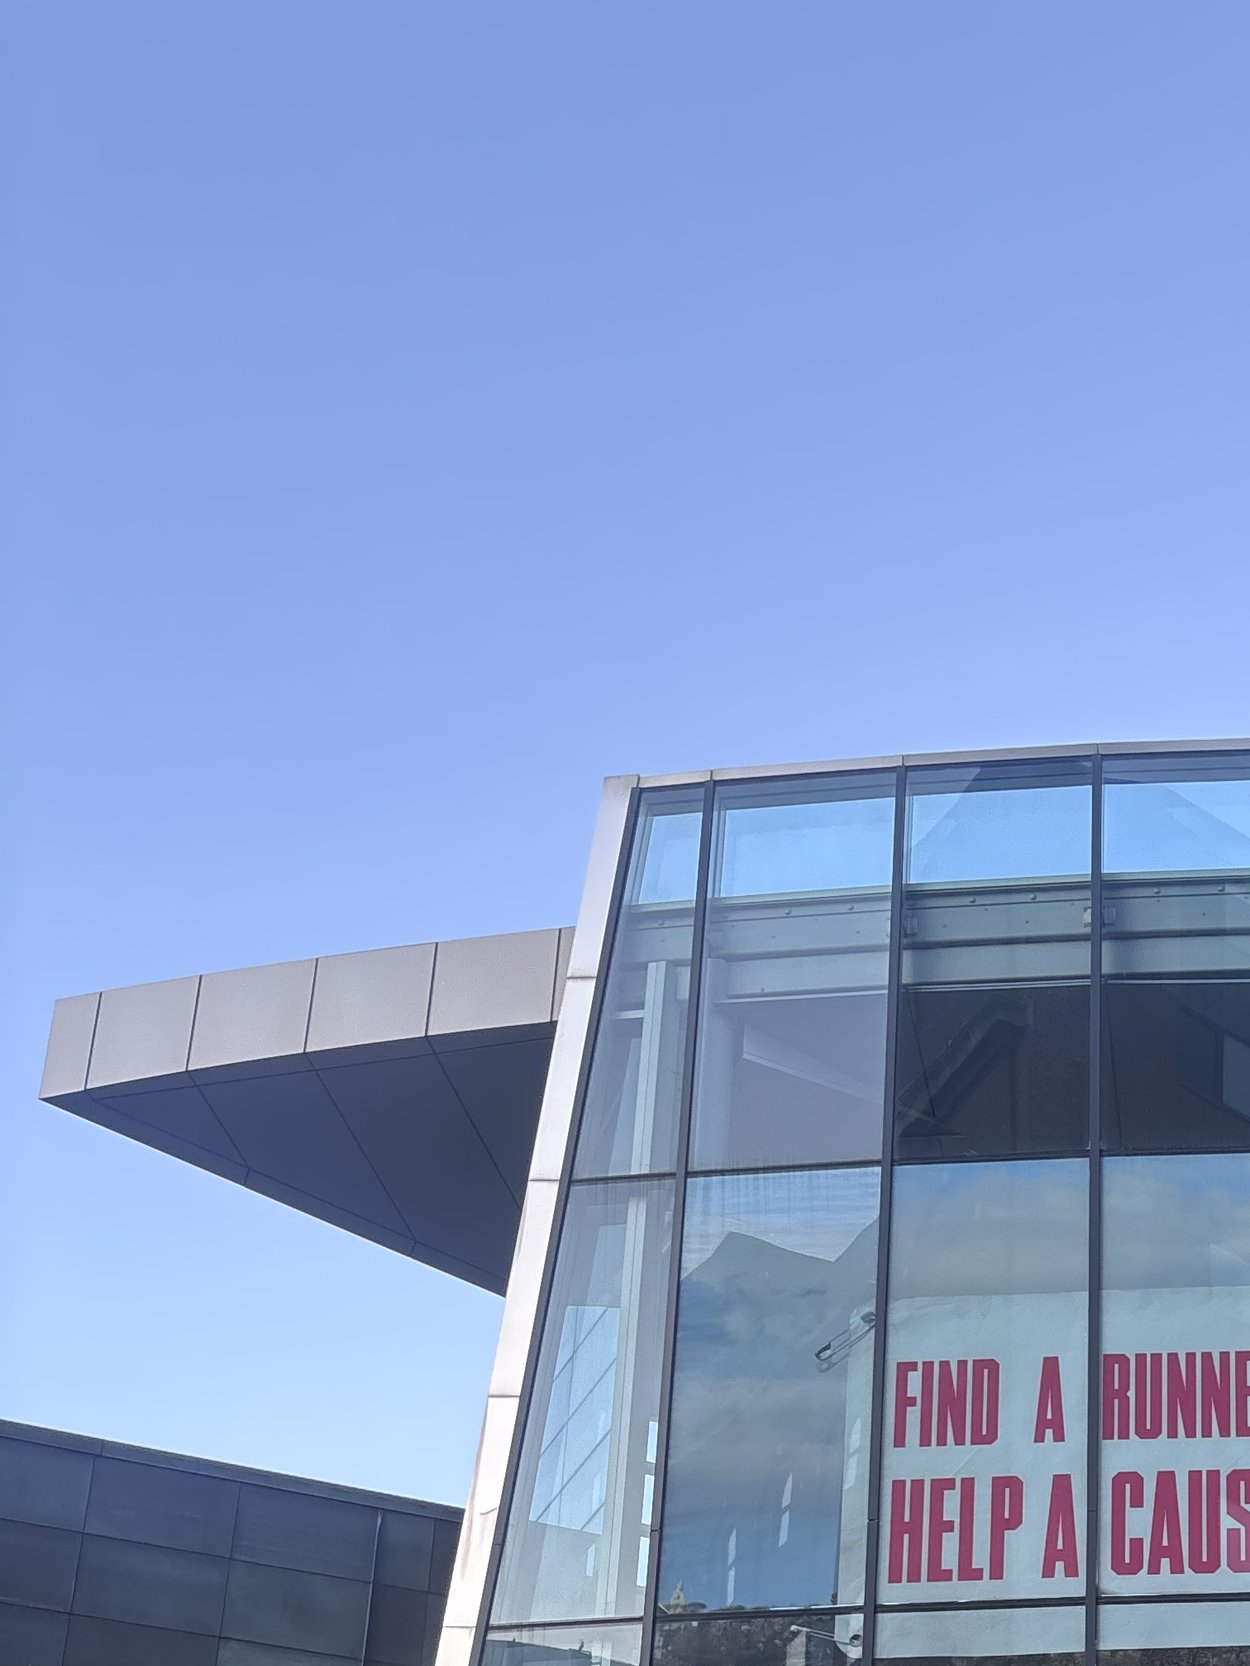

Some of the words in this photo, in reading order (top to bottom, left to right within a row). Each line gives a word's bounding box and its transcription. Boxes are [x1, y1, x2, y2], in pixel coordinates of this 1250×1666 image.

[893, 1359, 1000, 1448] FIND
[1034, 1356, 1066, 1443] A
[887, 1475, 1024, 1584] HELP
[1041, 1473, 1079, 1578] A
